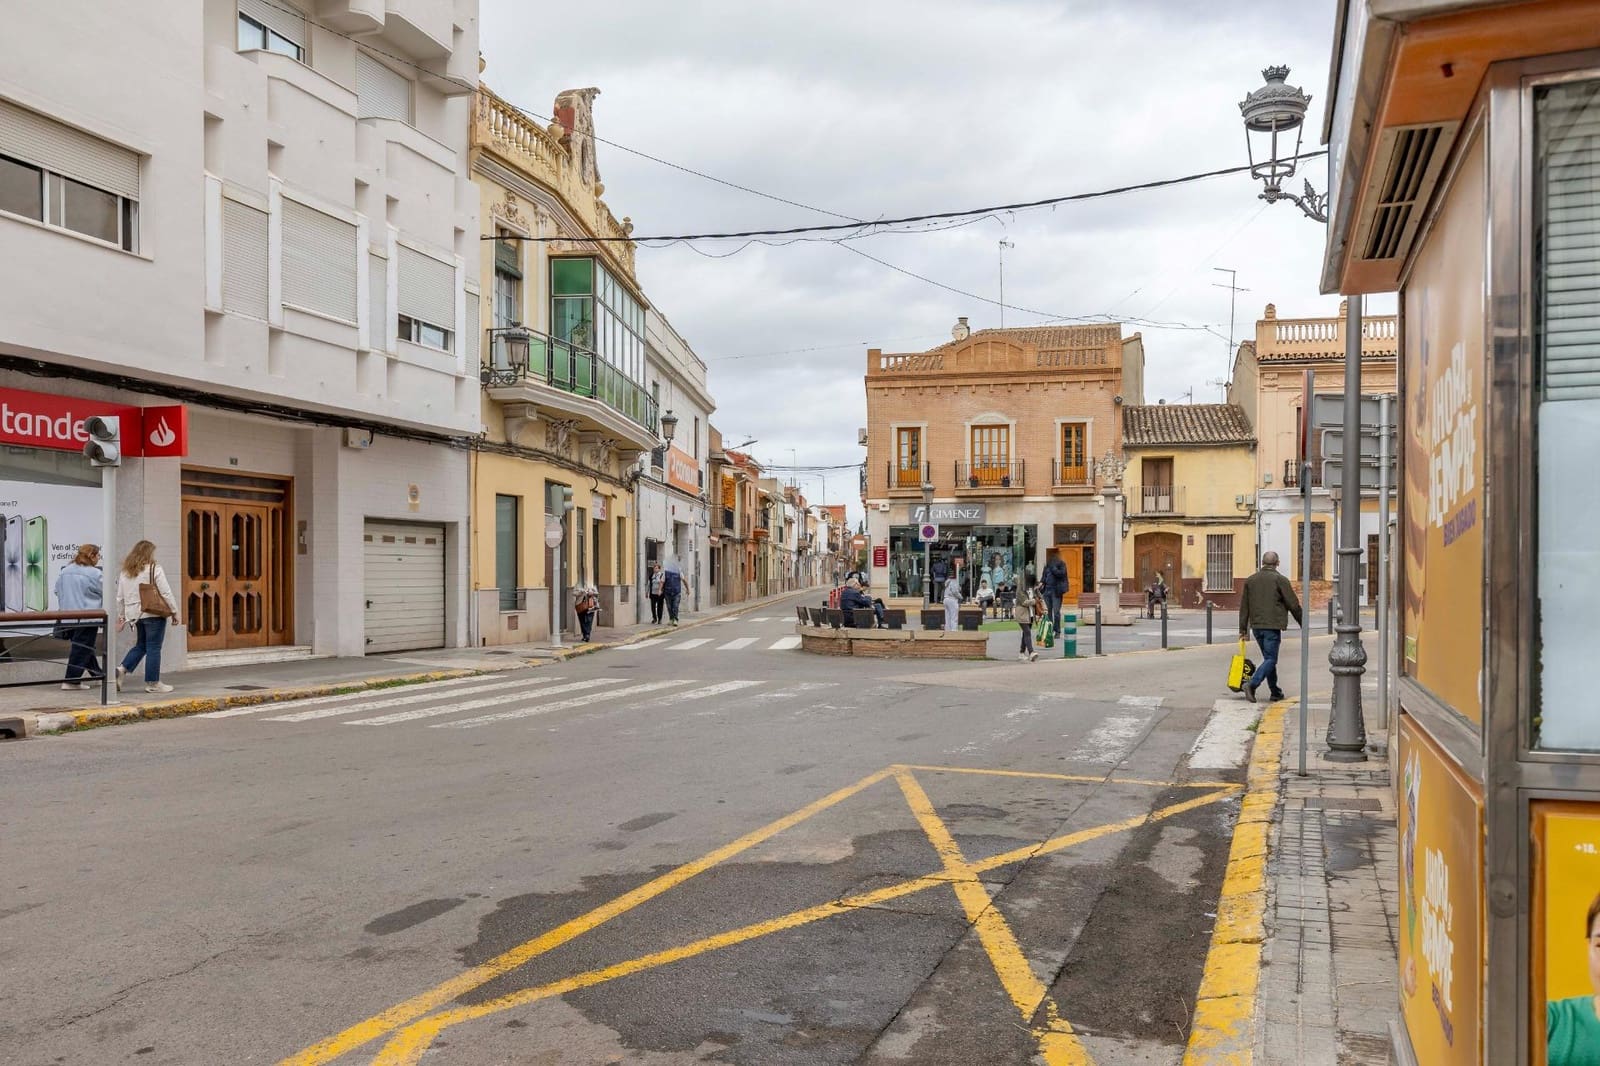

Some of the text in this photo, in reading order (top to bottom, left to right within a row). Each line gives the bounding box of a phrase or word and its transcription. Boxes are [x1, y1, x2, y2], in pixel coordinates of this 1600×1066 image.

[2, 403, 89, 442] tande
[929, 509, 980, 519] GIMENEZ
[51, 543, 65, 551] Ven
